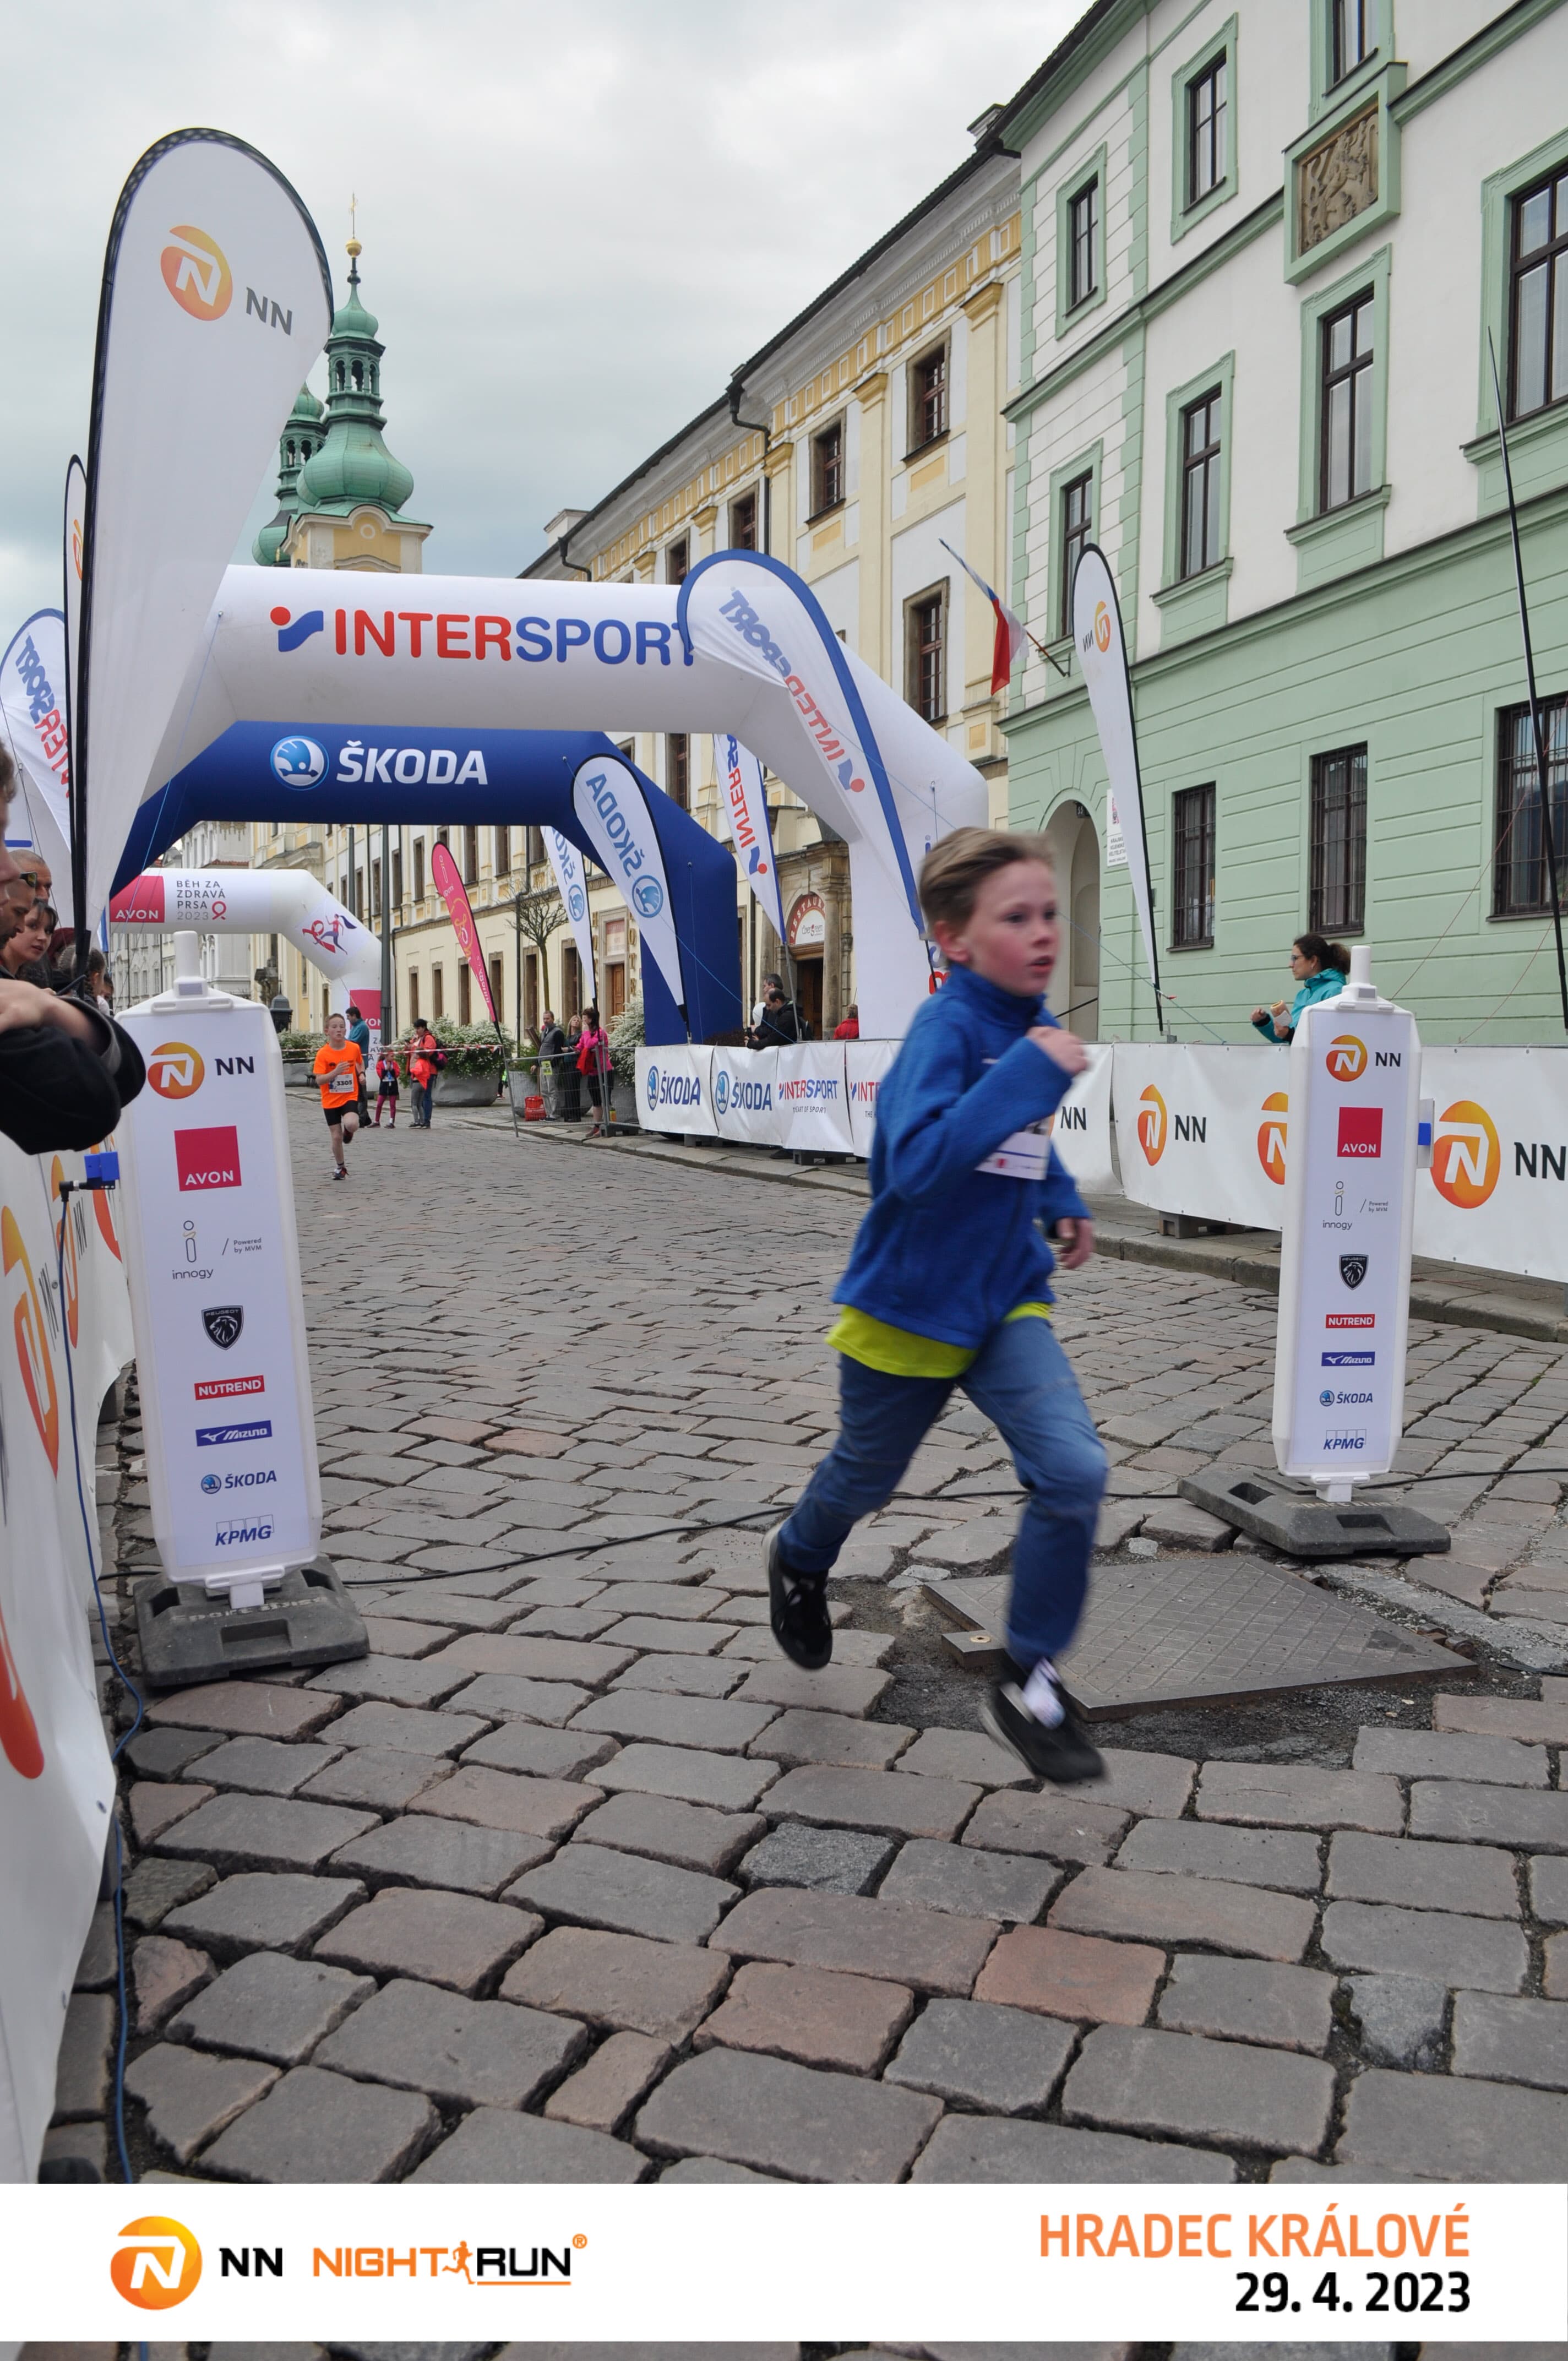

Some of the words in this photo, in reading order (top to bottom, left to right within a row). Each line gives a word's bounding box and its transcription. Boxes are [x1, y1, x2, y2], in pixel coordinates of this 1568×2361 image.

[246, 286, 293, 336] NN
[336, 739, 489, 786] ŠKODA
[176, 879, 199, 888] BĚH
[176, 888, 226, 898] ZDRAVÁ
[177, 901, 208, 909] PRSA
[115, 909, 159, 920] AVON
[177, 911, 209, 920] 2023
[214, 1056, 255, 1076] NN
[1375, 1052, 1401, 1067] NN
[659, 1070, 701, 1106] ŠKODA
[731, 1076, 772, 1111] ŠKODA
[784, 1079, 838, 1100] INTERSPORT
[1060, 1106, 1086, 1131] NN
[1174, 1114, 1207, 1143] NN
[1342, 1143, 1376, 1154] AVON
[1514, 1141, 1566, 1181] NN
[186, 1170, 234, 1185] AVON
[1322, 1220, 1353, 1231] innogy
[233, 1238, 262, 1246] Powered
[172, 1269, 214, 1280] innogy
[205, 1308, 239, 1317] PEUGEOT
[1328, 1316, 1373, 1326] NUTREND
[198, 1378, 262, 1396] NUTREND
[1336, 1391, 1373, 1403] ŠKODA
[1323, 1437, 1365, 1450] KPMG
[224, 1470, 277, 1489] ŠKODA
[215, 1525, 273, 1547] KPMG
